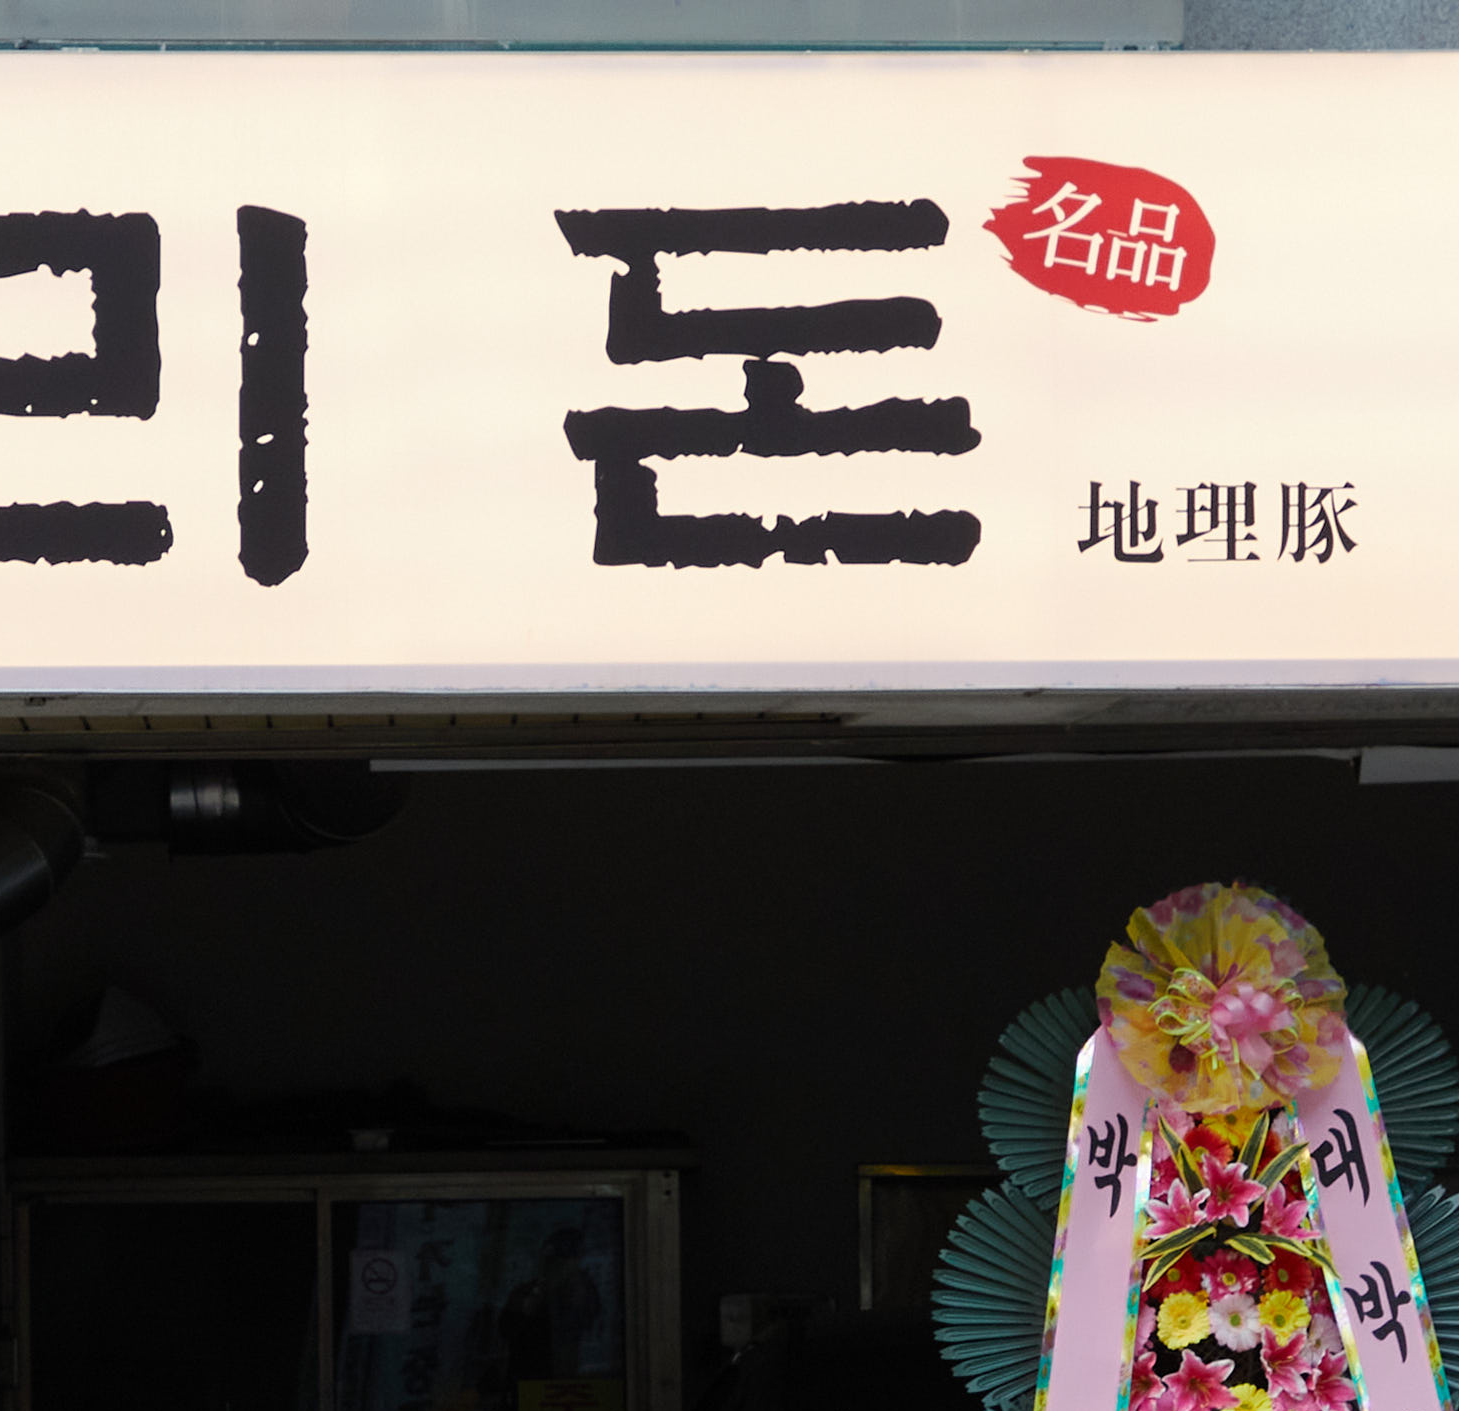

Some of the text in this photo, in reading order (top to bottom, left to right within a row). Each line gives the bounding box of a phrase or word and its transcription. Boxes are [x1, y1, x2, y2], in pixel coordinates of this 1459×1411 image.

[1022, 182, 1189, 294] 名品
[1077, 479, 1359, 564] 地理豚
